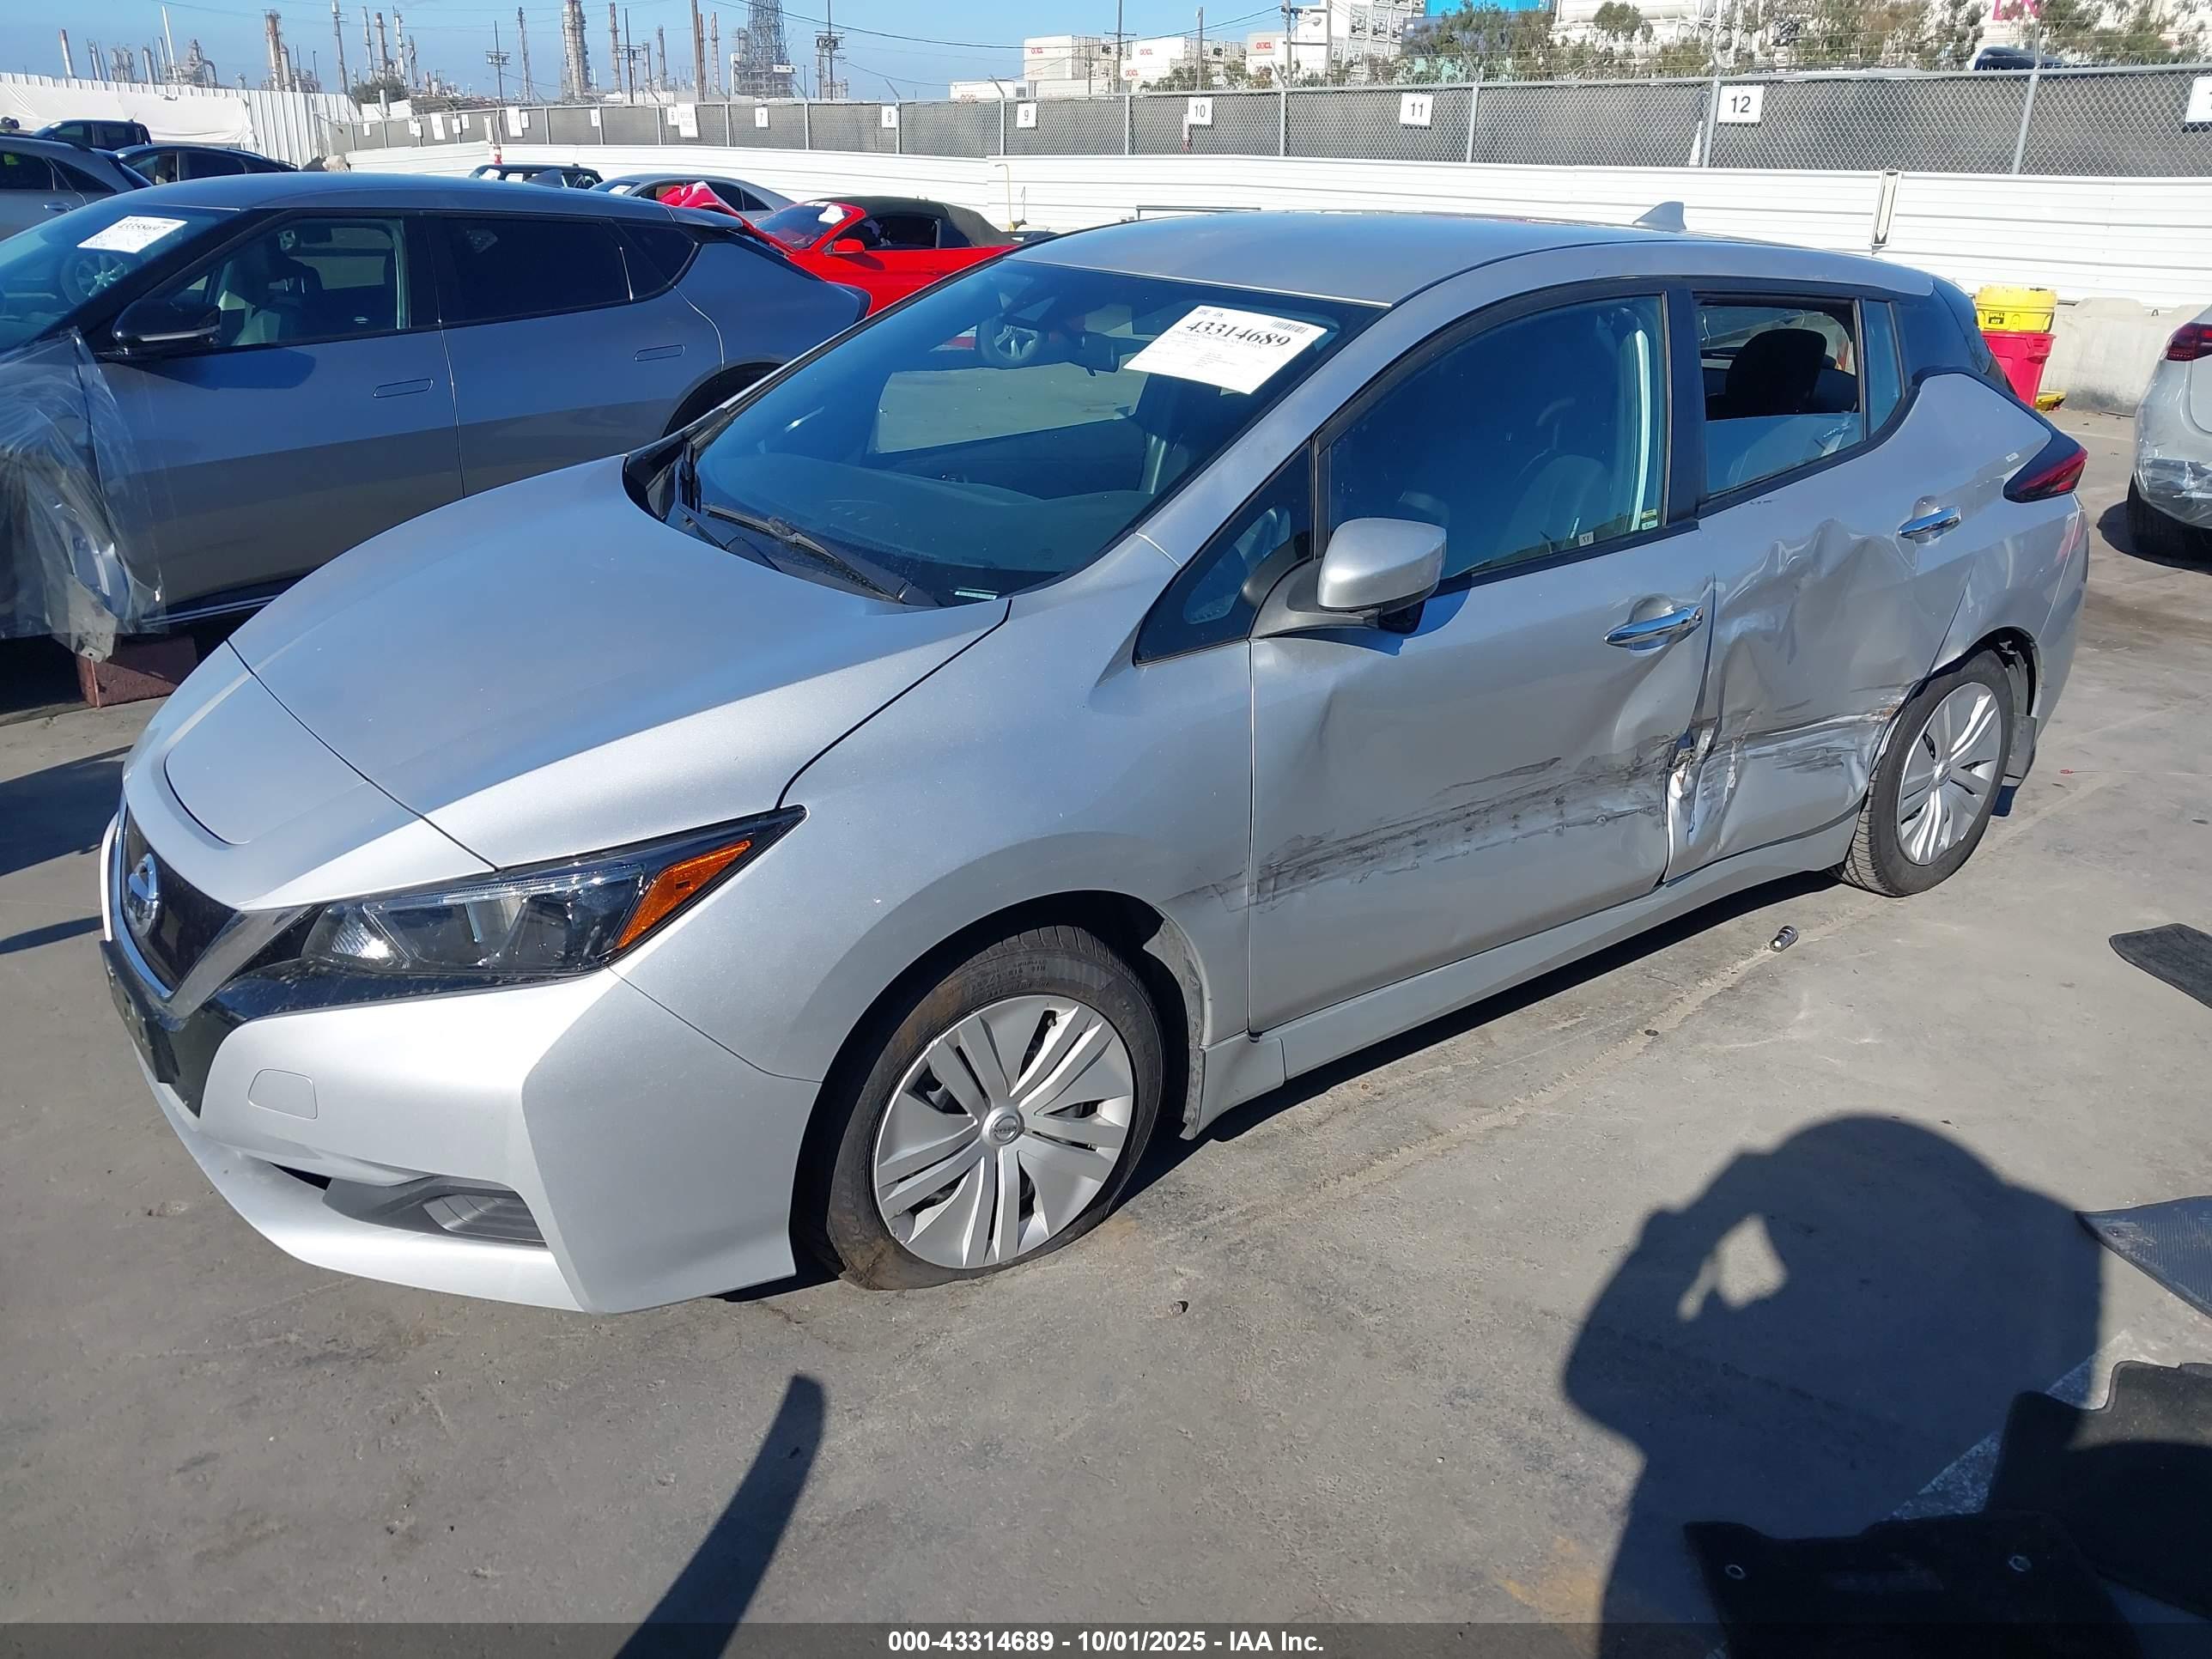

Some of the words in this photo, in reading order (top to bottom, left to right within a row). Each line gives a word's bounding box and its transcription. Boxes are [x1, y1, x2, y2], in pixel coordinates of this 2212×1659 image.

[1194, 104, 1206, 118] 10
[1411, 102, 1424, 117] 11
[1731, 95, 1751, 113] 12
[887, 112, 892, 122] 8
[1024, 109, 1030, 121] 9
[1186, 320, 1291, 348] 43314689
